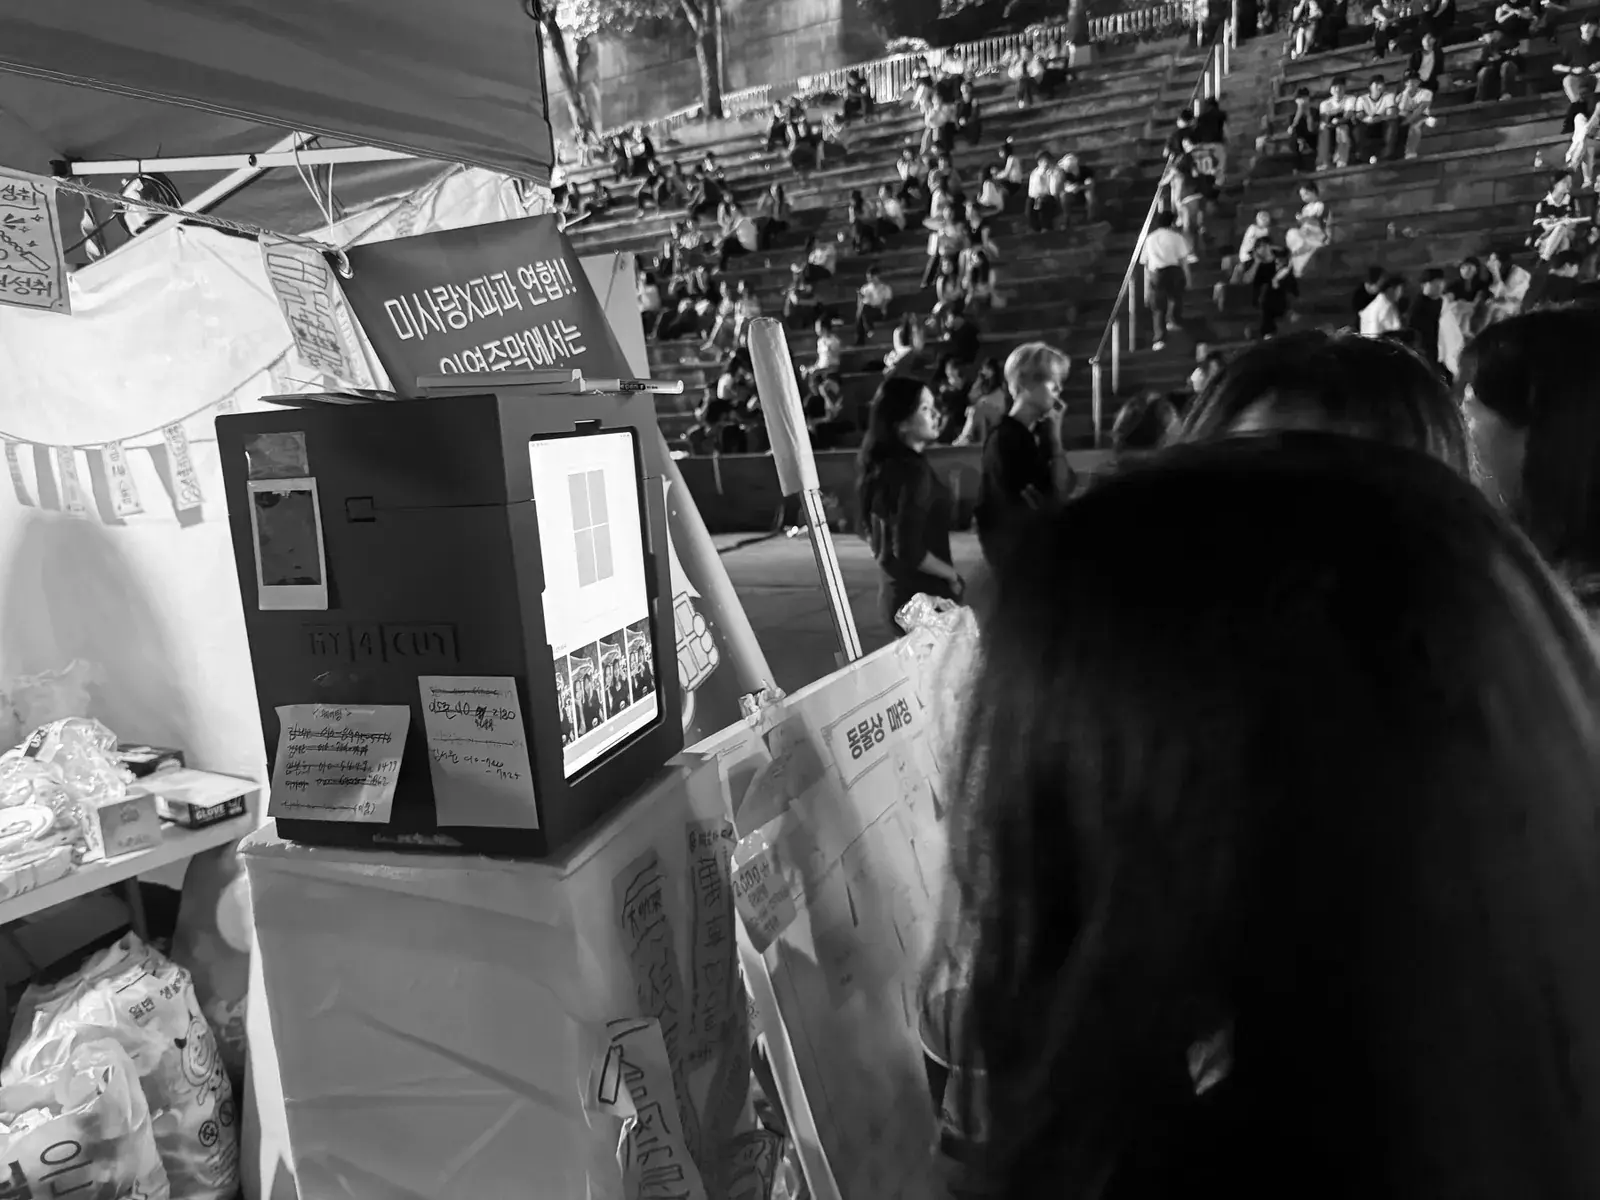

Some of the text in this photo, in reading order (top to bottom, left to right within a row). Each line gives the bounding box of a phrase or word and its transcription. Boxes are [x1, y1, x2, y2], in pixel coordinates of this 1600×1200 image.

[517, 257, 577, 306] 연합!!
[846, 697, 913, 760] 동물상 매칭
[195, 804, 226, 821] GLOVE
[129, 997, 156, 1019] 일반
